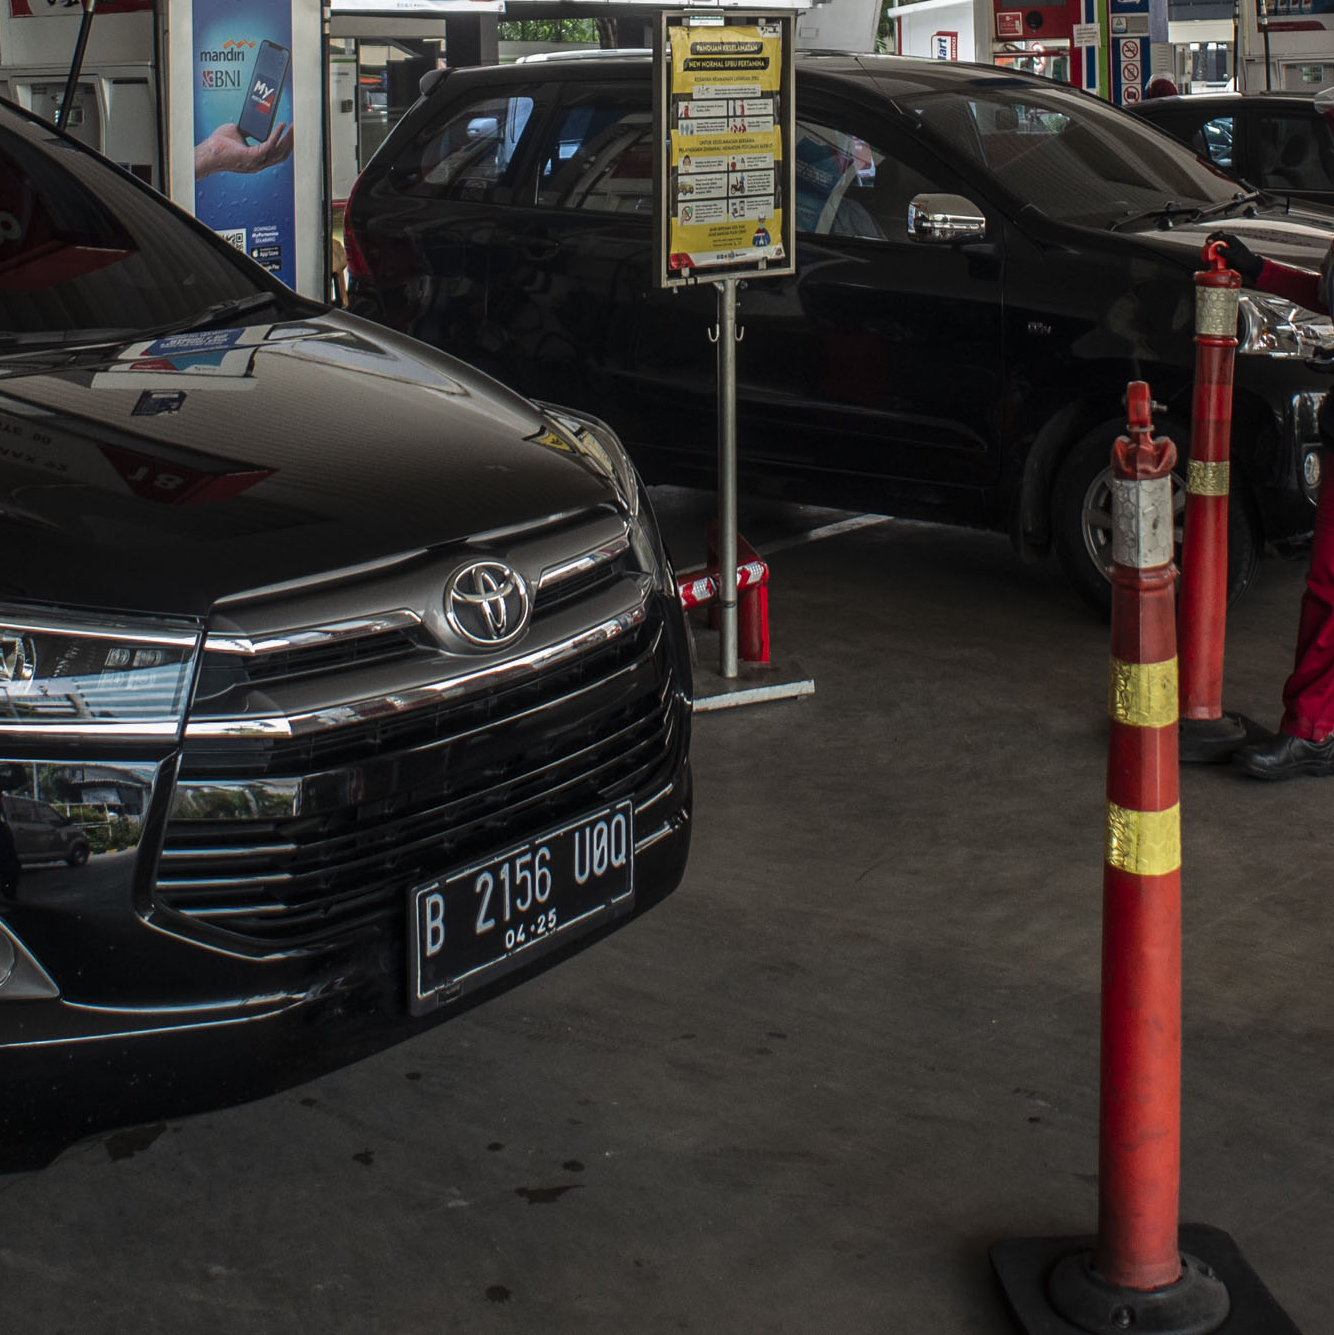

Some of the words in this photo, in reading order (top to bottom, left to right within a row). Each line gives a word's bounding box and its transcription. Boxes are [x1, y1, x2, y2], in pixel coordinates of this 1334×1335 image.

[200, 47, 245, 62] mandiri
[705, 60, 724, 68] NORMAL
[737, 59, 765, 67] PERTAMINA
[214, 70, 241, 88] BNI
[425, 892, 446, 957] B
[474, 846, 551, 935] 2156
